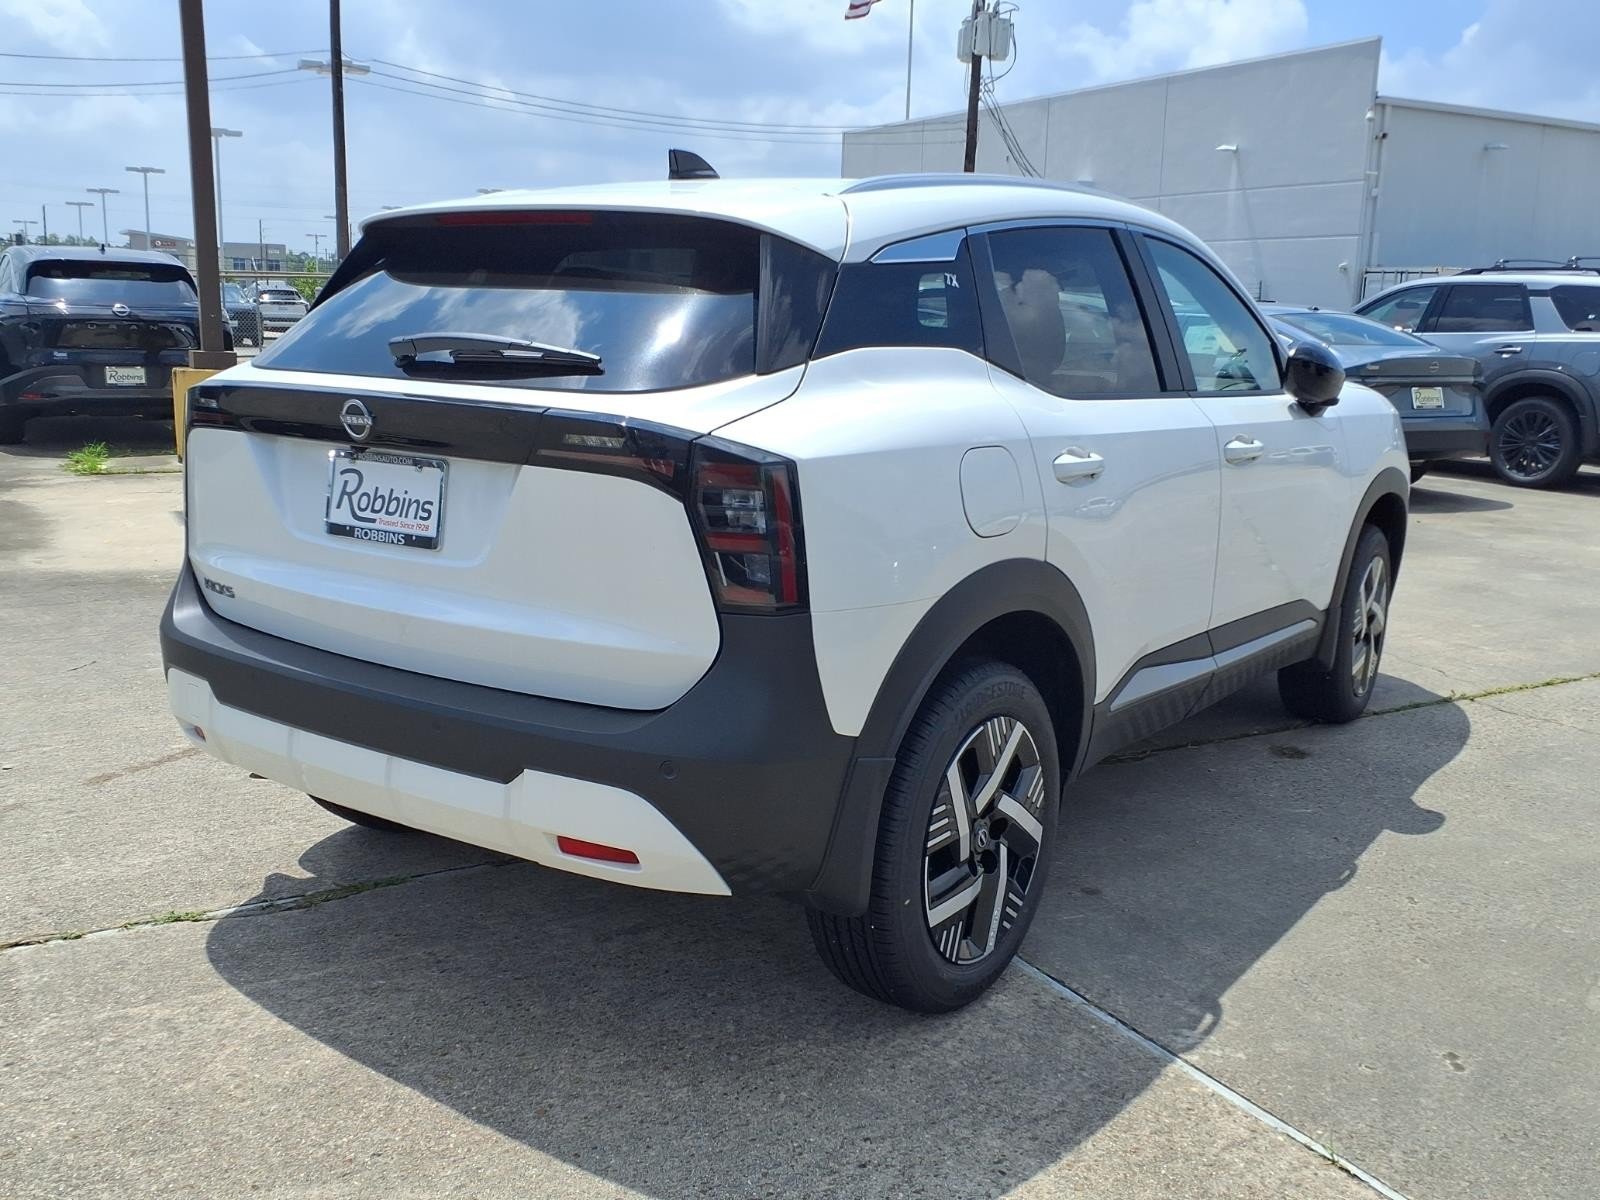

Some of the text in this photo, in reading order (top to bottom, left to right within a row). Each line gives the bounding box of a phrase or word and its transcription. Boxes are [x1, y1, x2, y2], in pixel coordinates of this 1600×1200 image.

[944, 272, 960, 288] TX
[108, 370, 143, 382] Robbins
[336, 468, 434, 523] Robbins
[378, 517, 398, 528] Trusted
[399, 520, 414, 530] Since
[354, 528, 405, 545] ROBBINS
